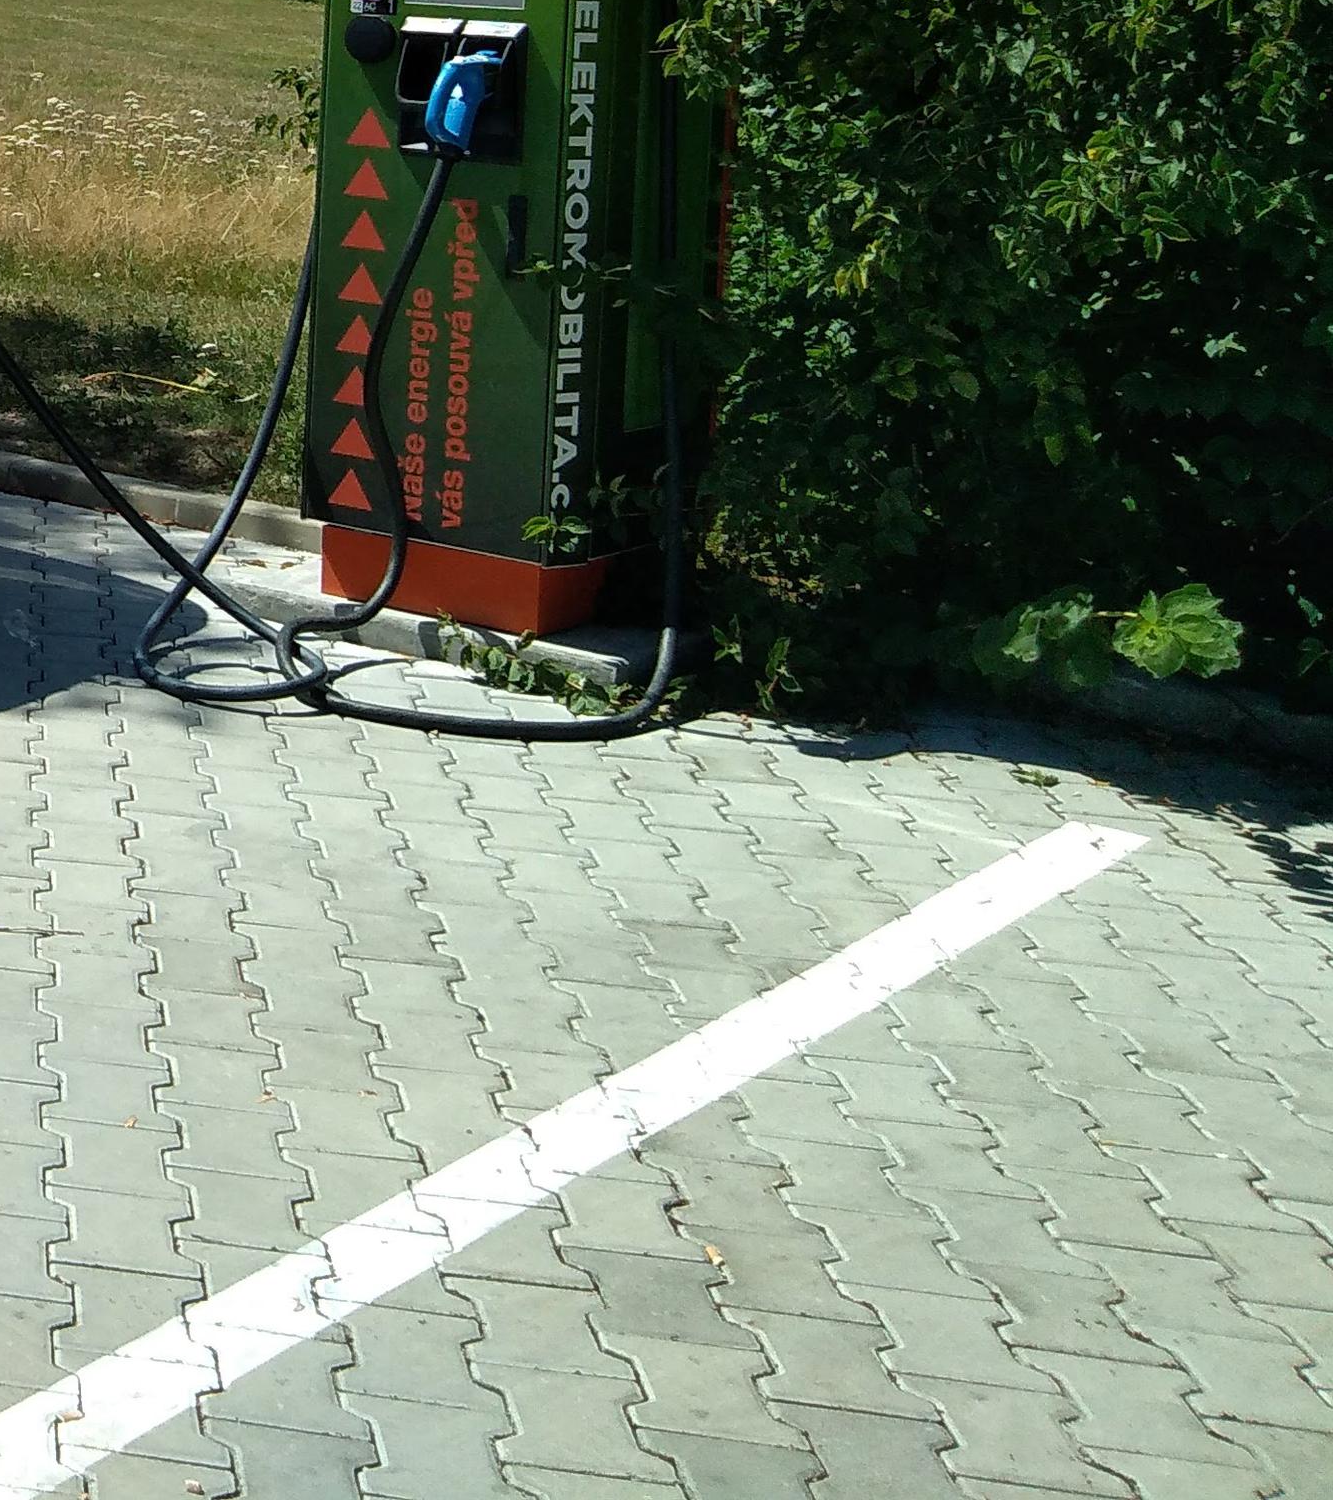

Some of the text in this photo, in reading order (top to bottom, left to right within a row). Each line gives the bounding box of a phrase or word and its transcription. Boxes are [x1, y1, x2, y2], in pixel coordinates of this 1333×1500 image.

[405, 286, 438, 426] energie
[435, 197, 481, 530] vás posouvá vpřed
